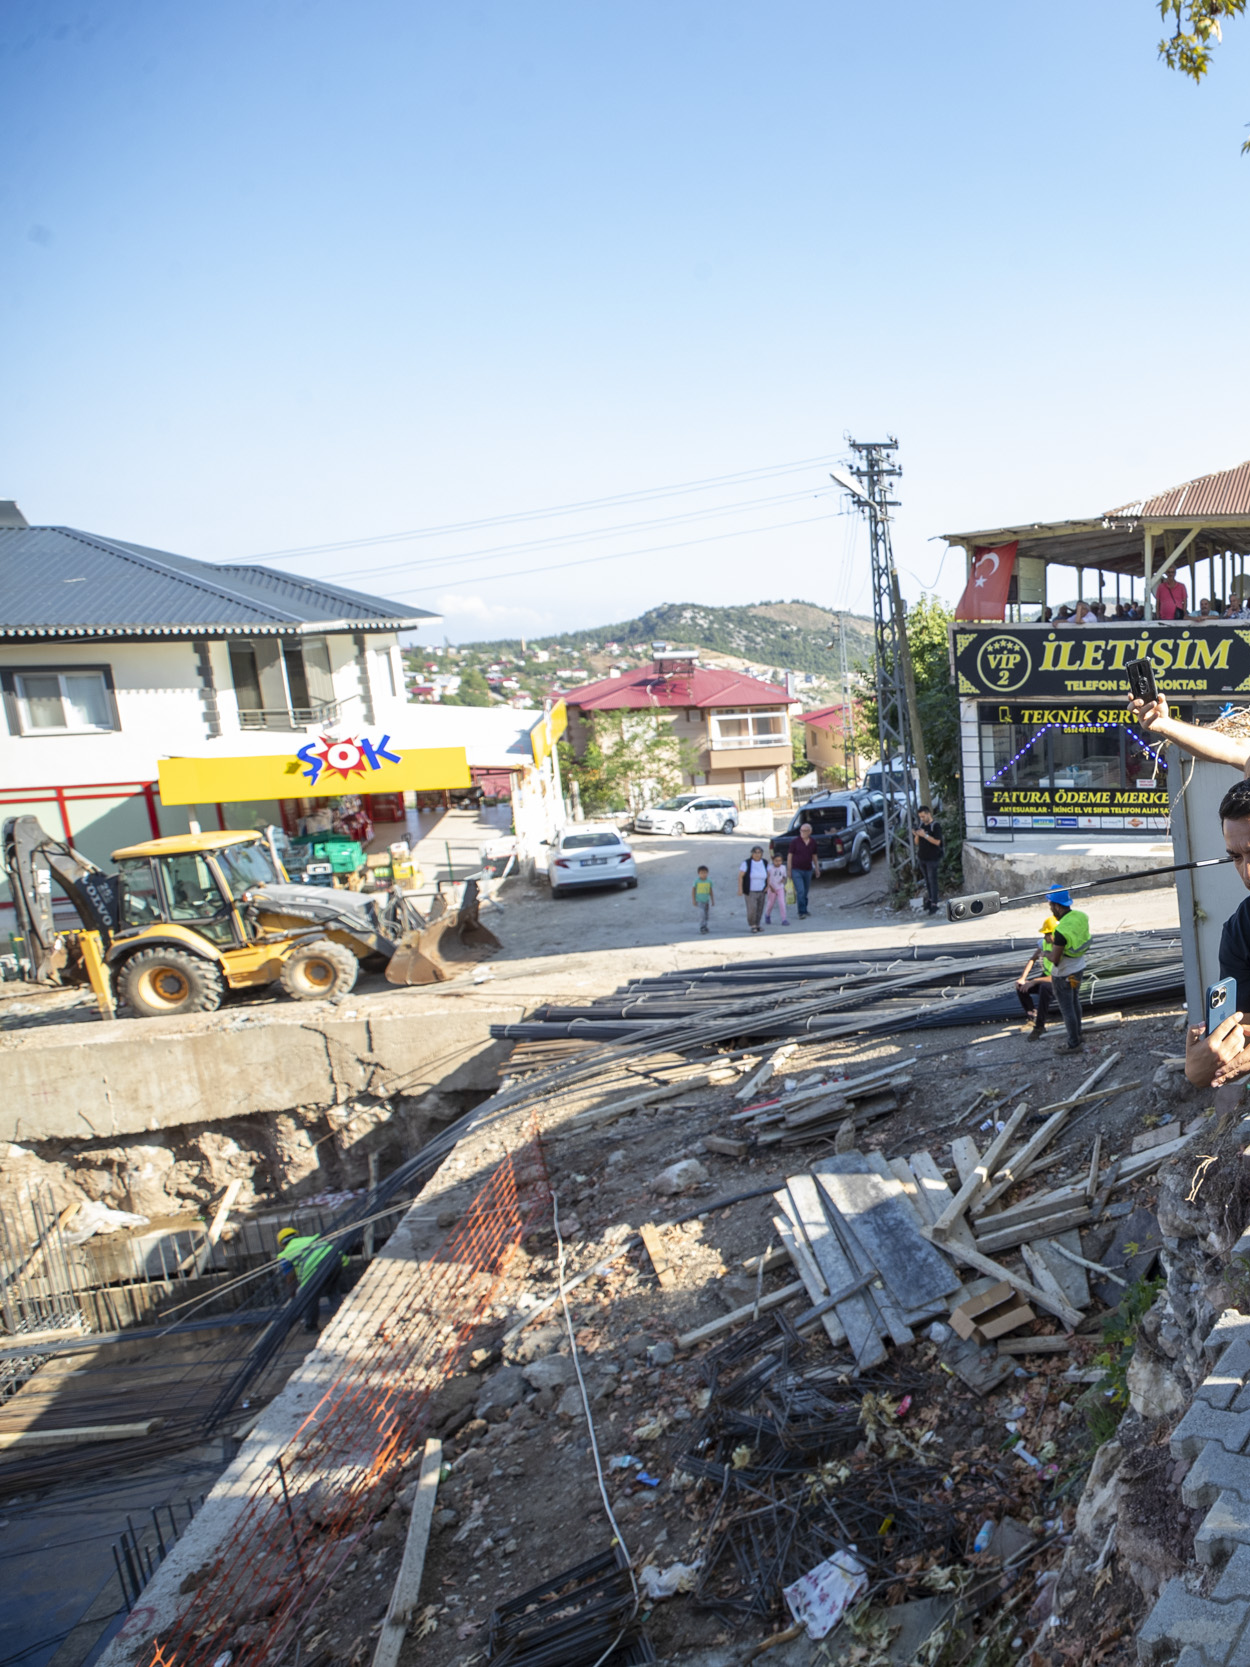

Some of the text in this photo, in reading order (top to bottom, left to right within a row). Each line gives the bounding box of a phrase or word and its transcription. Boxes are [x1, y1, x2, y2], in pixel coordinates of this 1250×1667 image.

[1038, 631, 1234, 678] İLETİŞİM
[997, 670, 1010, 685] 2
[1065, 680, 1118, 691] TELEFON
[1156, 679, 1207, 691] NOKTASI
[1020, 706, 1093, 724] TEKNİK
[296, 734, 402, 786] ŞOK
[992, 788, 1169, 804] FATURA ÖDEME MERKE
[1052, 805, 1074, 813] İKİNCİ
[1082, 806, 1092, 814] VE
[1093, 806, 1110, 814] SIFIR
